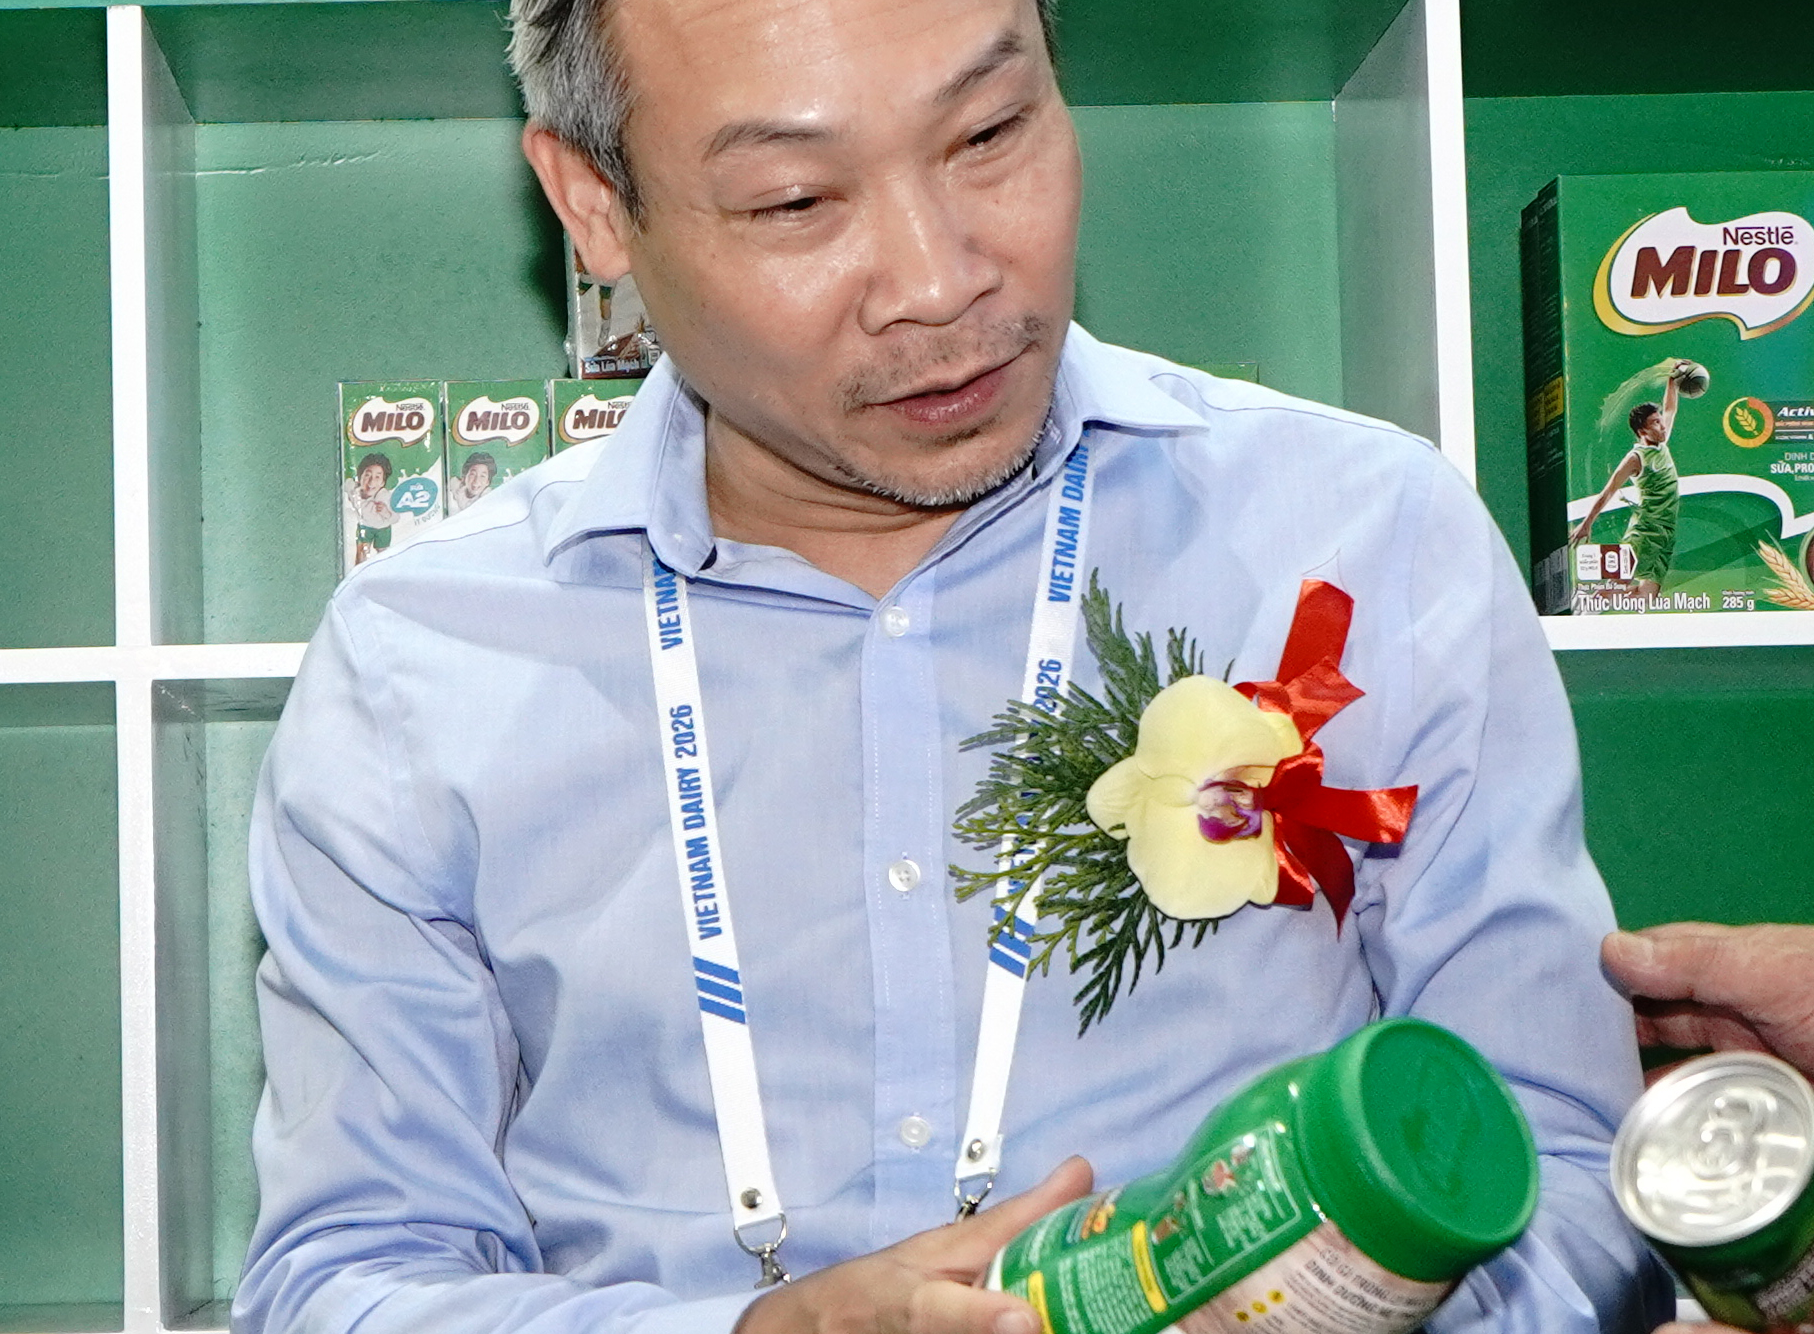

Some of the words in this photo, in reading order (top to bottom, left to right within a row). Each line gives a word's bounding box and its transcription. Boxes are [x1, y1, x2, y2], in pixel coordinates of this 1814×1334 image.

[1630, 245, 1798, 299] MILO
[361, 411, 425, 434] MILO
[395, 491, 430, 510] A2
[1048, 505, 1082, 603] VIETNAM
[1578, 590, 1609, 612] Thức
[1612, 589, 1646, 614] Uống
[1674, 592, 1711, 613] Mạch
[1722, 596, 1744, 610] 285
[1747, 598, 1755, 612] g
[675, 705, 693, 759] 2026
[679, 766, 705, 831] DAIRY
[683, 835, 722, 940] VIETNAM
